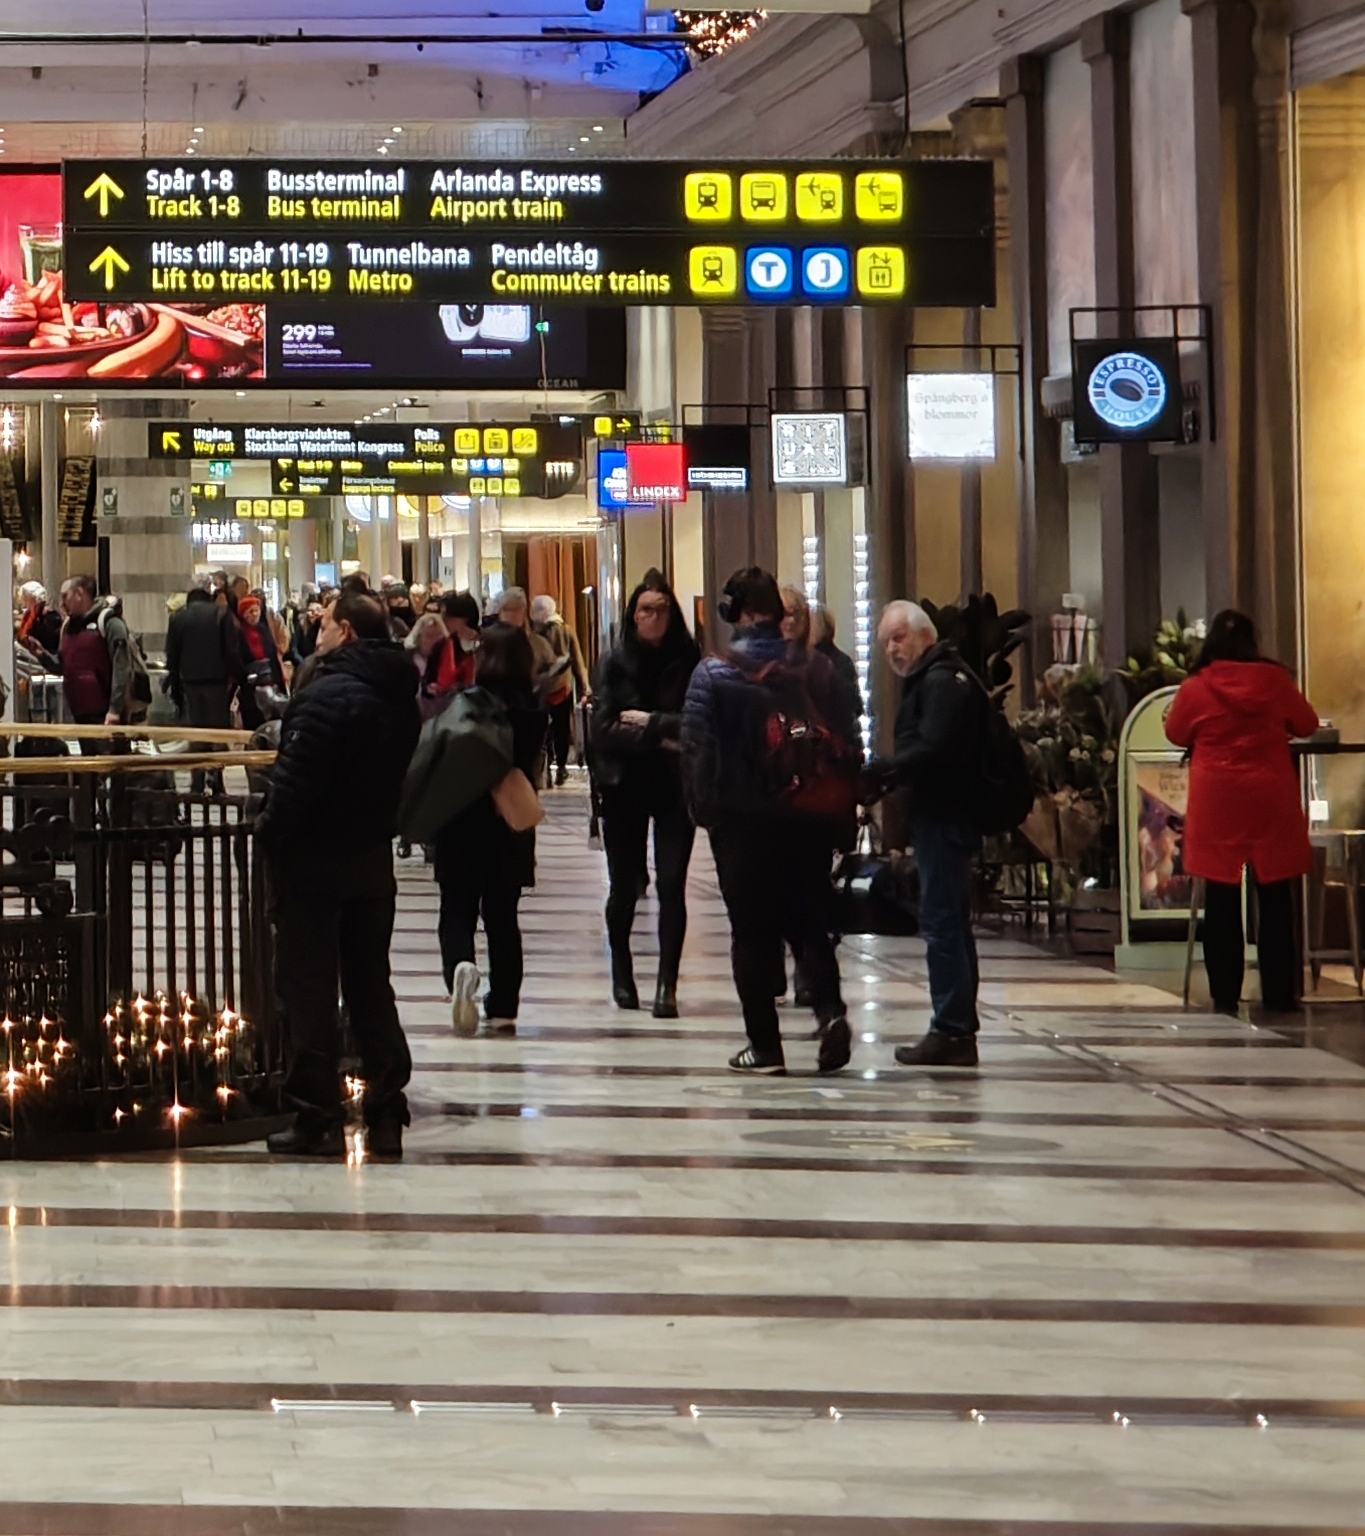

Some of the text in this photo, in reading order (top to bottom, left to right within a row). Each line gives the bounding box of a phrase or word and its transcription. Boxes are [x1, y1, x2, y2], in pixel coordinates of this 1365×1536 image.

[146, 167, 233, 195] Spår 1-8
[268, 168, 404, 192] Bussterminal
[430, 169, 602, 196] Arlanda Express
[146, 194, 240, 217] Track 1-8
[268, 195, 400, 218] Bus terminal
[430, 196, 563, 224] Airport train
[152, 240, 328, 269] Hiss till spår 11-19
[347, 241, 470, 265] Tunnelbana
[491, 242, 598, 270] Pendeltåg
[152, 267, 331, 290] Lift to track 11-19
[348, 270, 412, 291] Metro
[491, 270, 670, 292] Commuter trains
[758, 261, 778, 282] T
[820, 259, 830, 282] J
[282, 324, 316, 342] 299
[1094, 358, 1158, 385] ESPRESSO
[924, 407, 978, 420] blommor
[1102, 403, 1151, 422] HOUSE
[194, 427, 232, 442] Utgång
[244, 427, 350, 442] Klarabergsviadukten
[414, 428, 439, 441] Polis
[194, 441, 235, 454] Way out
[244, 440, 404, 455] Stockholm Waterfront Kongress
[415, 442, 445, 453] Police
[632, 486, 680, 497] LINDEX
